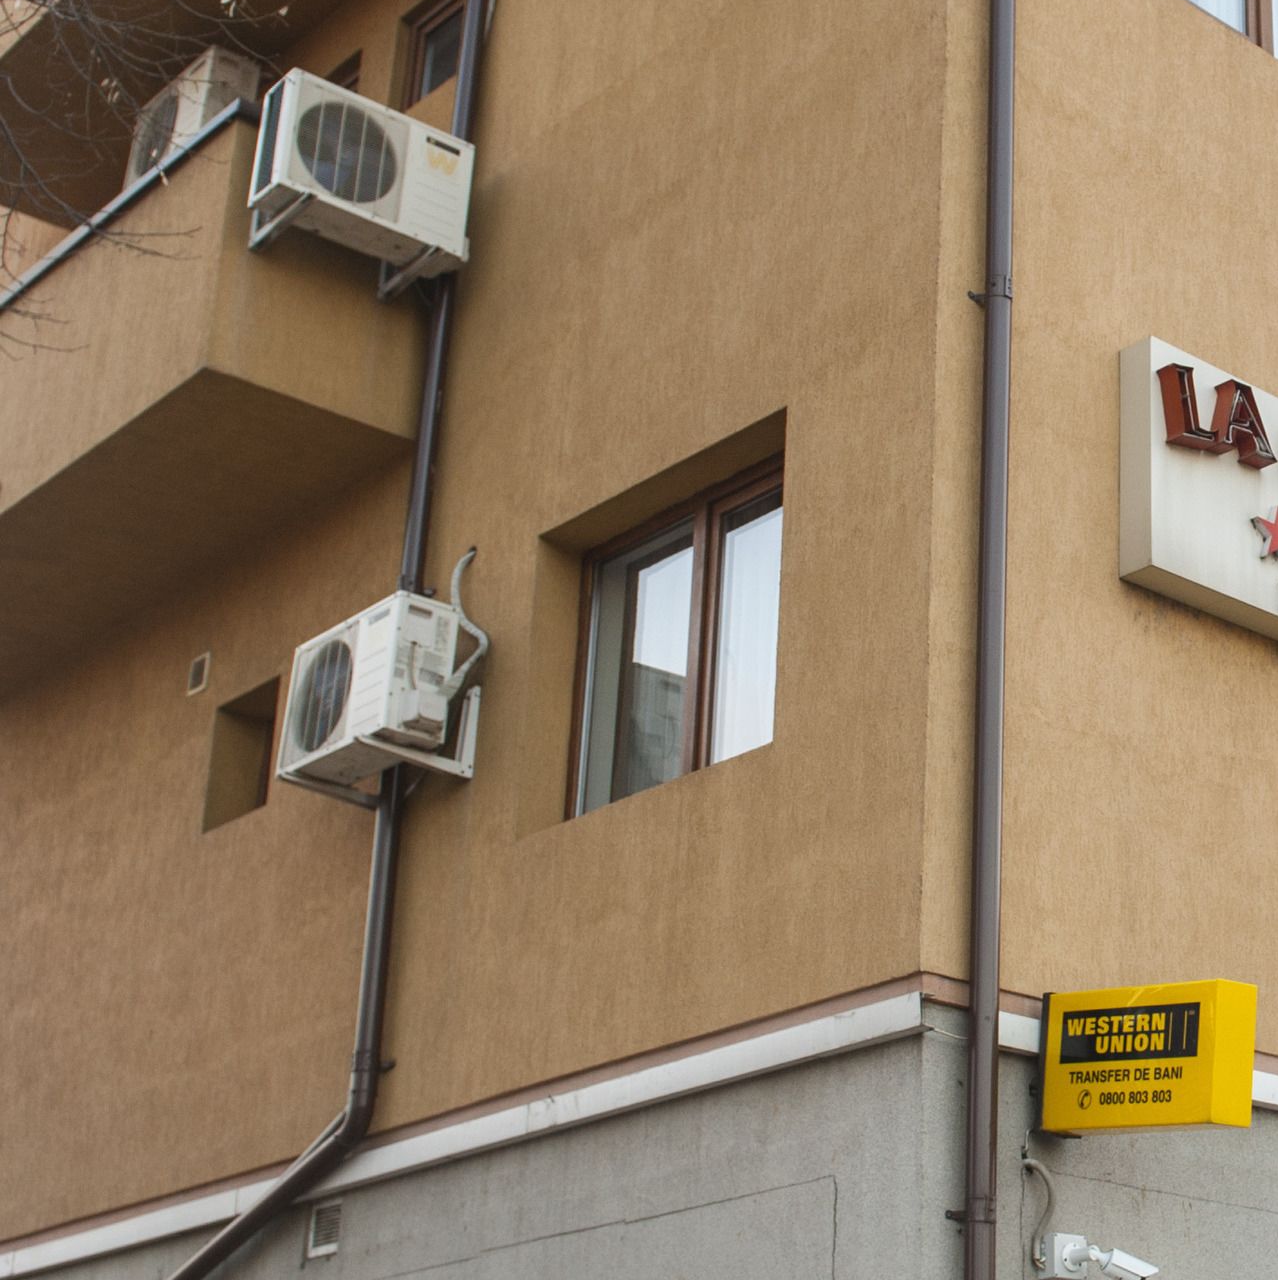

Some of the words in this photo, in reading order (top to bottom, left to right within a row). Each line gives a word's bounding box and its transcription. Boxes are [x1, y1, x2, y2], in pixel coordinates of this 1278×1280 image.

[1156, 363, 1278, 470] LA
[1067, 1012, 1166, 1037] WESTERN
[1095, 1032, 1165, 1054] UNION
[1069, 1069, 1130, 1084] TRANSFER
[1134, 1067, 1151, 1081] DE
[1154, 1065, 1183, 1080] BANI
[1099, 1091, 1126, 1106] 0800
[1128, 1090, 1148, 1104] 803
[1151, 1089, 1172, 1103] 803
